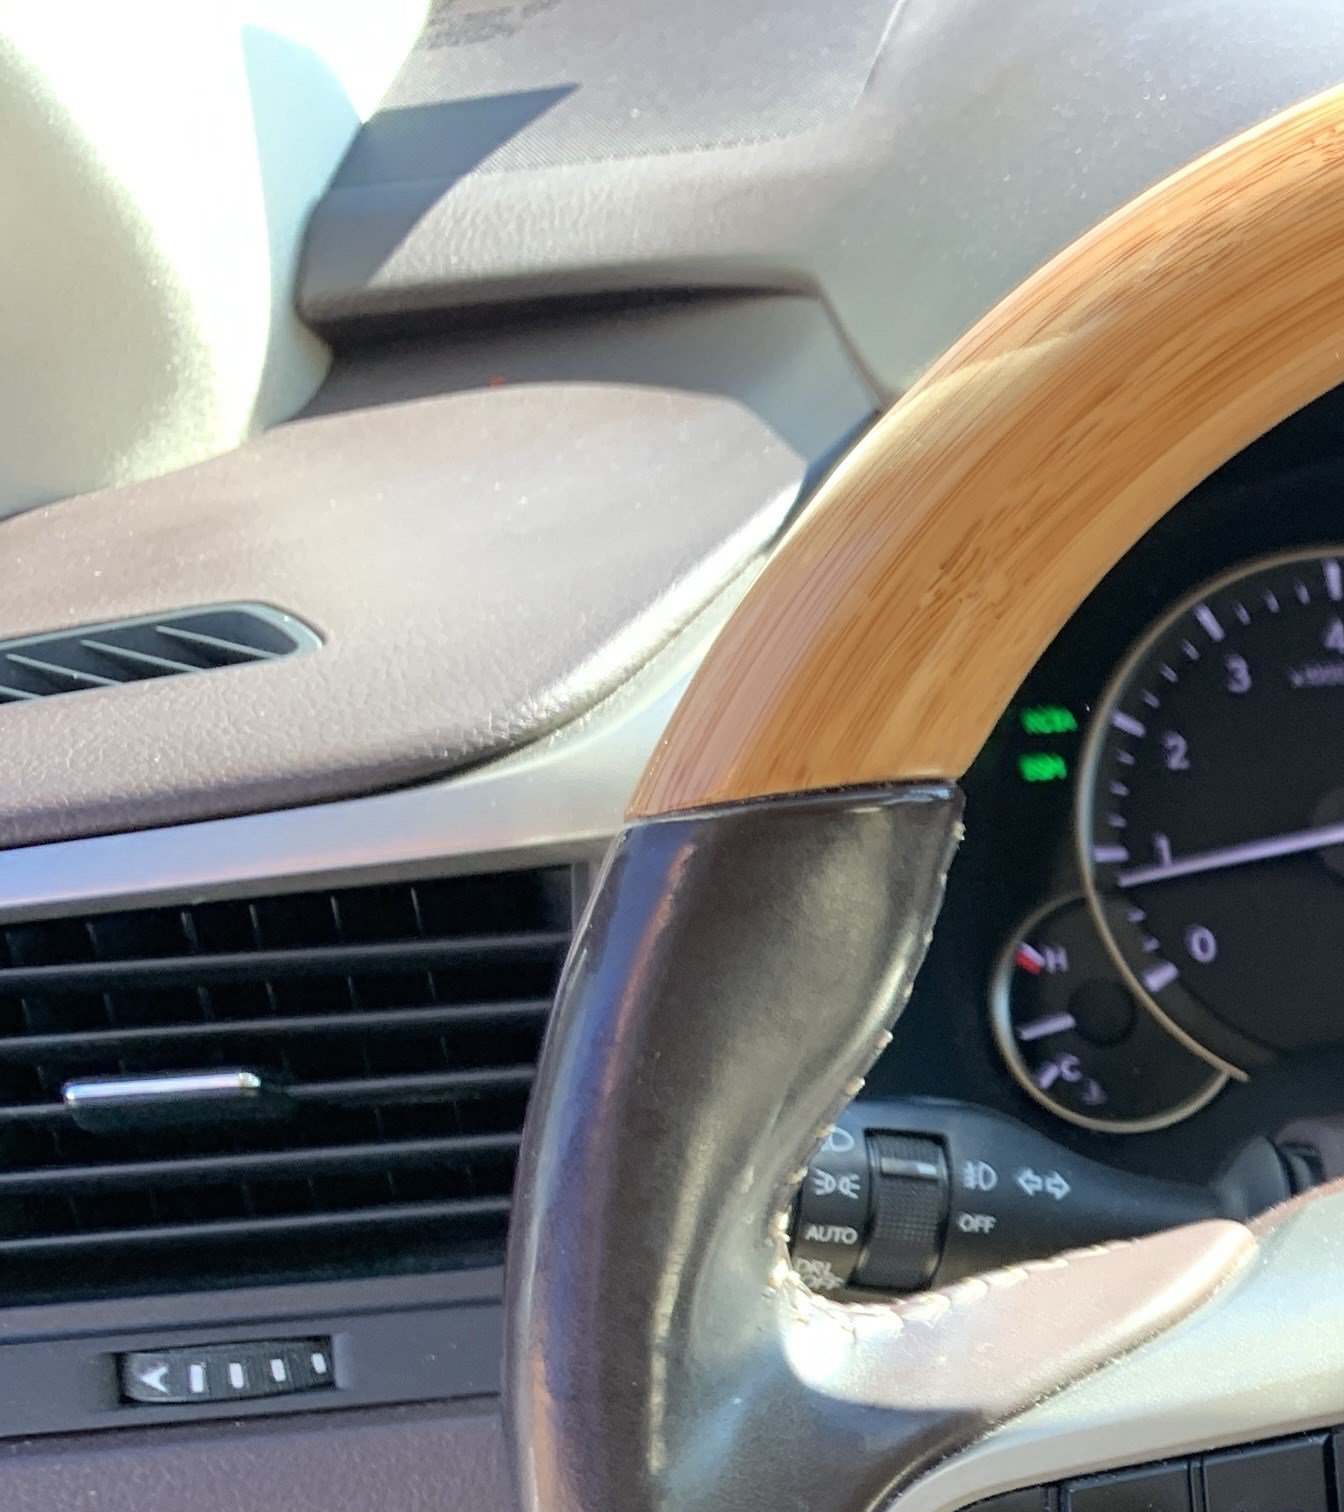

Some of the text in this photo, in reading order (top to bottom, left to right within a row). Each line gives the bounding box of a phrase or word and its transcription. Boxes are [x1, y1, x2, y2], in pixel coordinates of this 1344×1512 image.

[1225, 654, 1252, 693] 3
[1164, 731, 1190, 771] 2
[1155, 833, 1172, 868] 1
[1045, 945, 1069, 973] H
[1186, 925, 1216, 963] 0
[1060, 1053, 1083, 1082] C
[804, 1223, 859, 1246] AUTO
[956, 1211, 997, 1234] OFF
